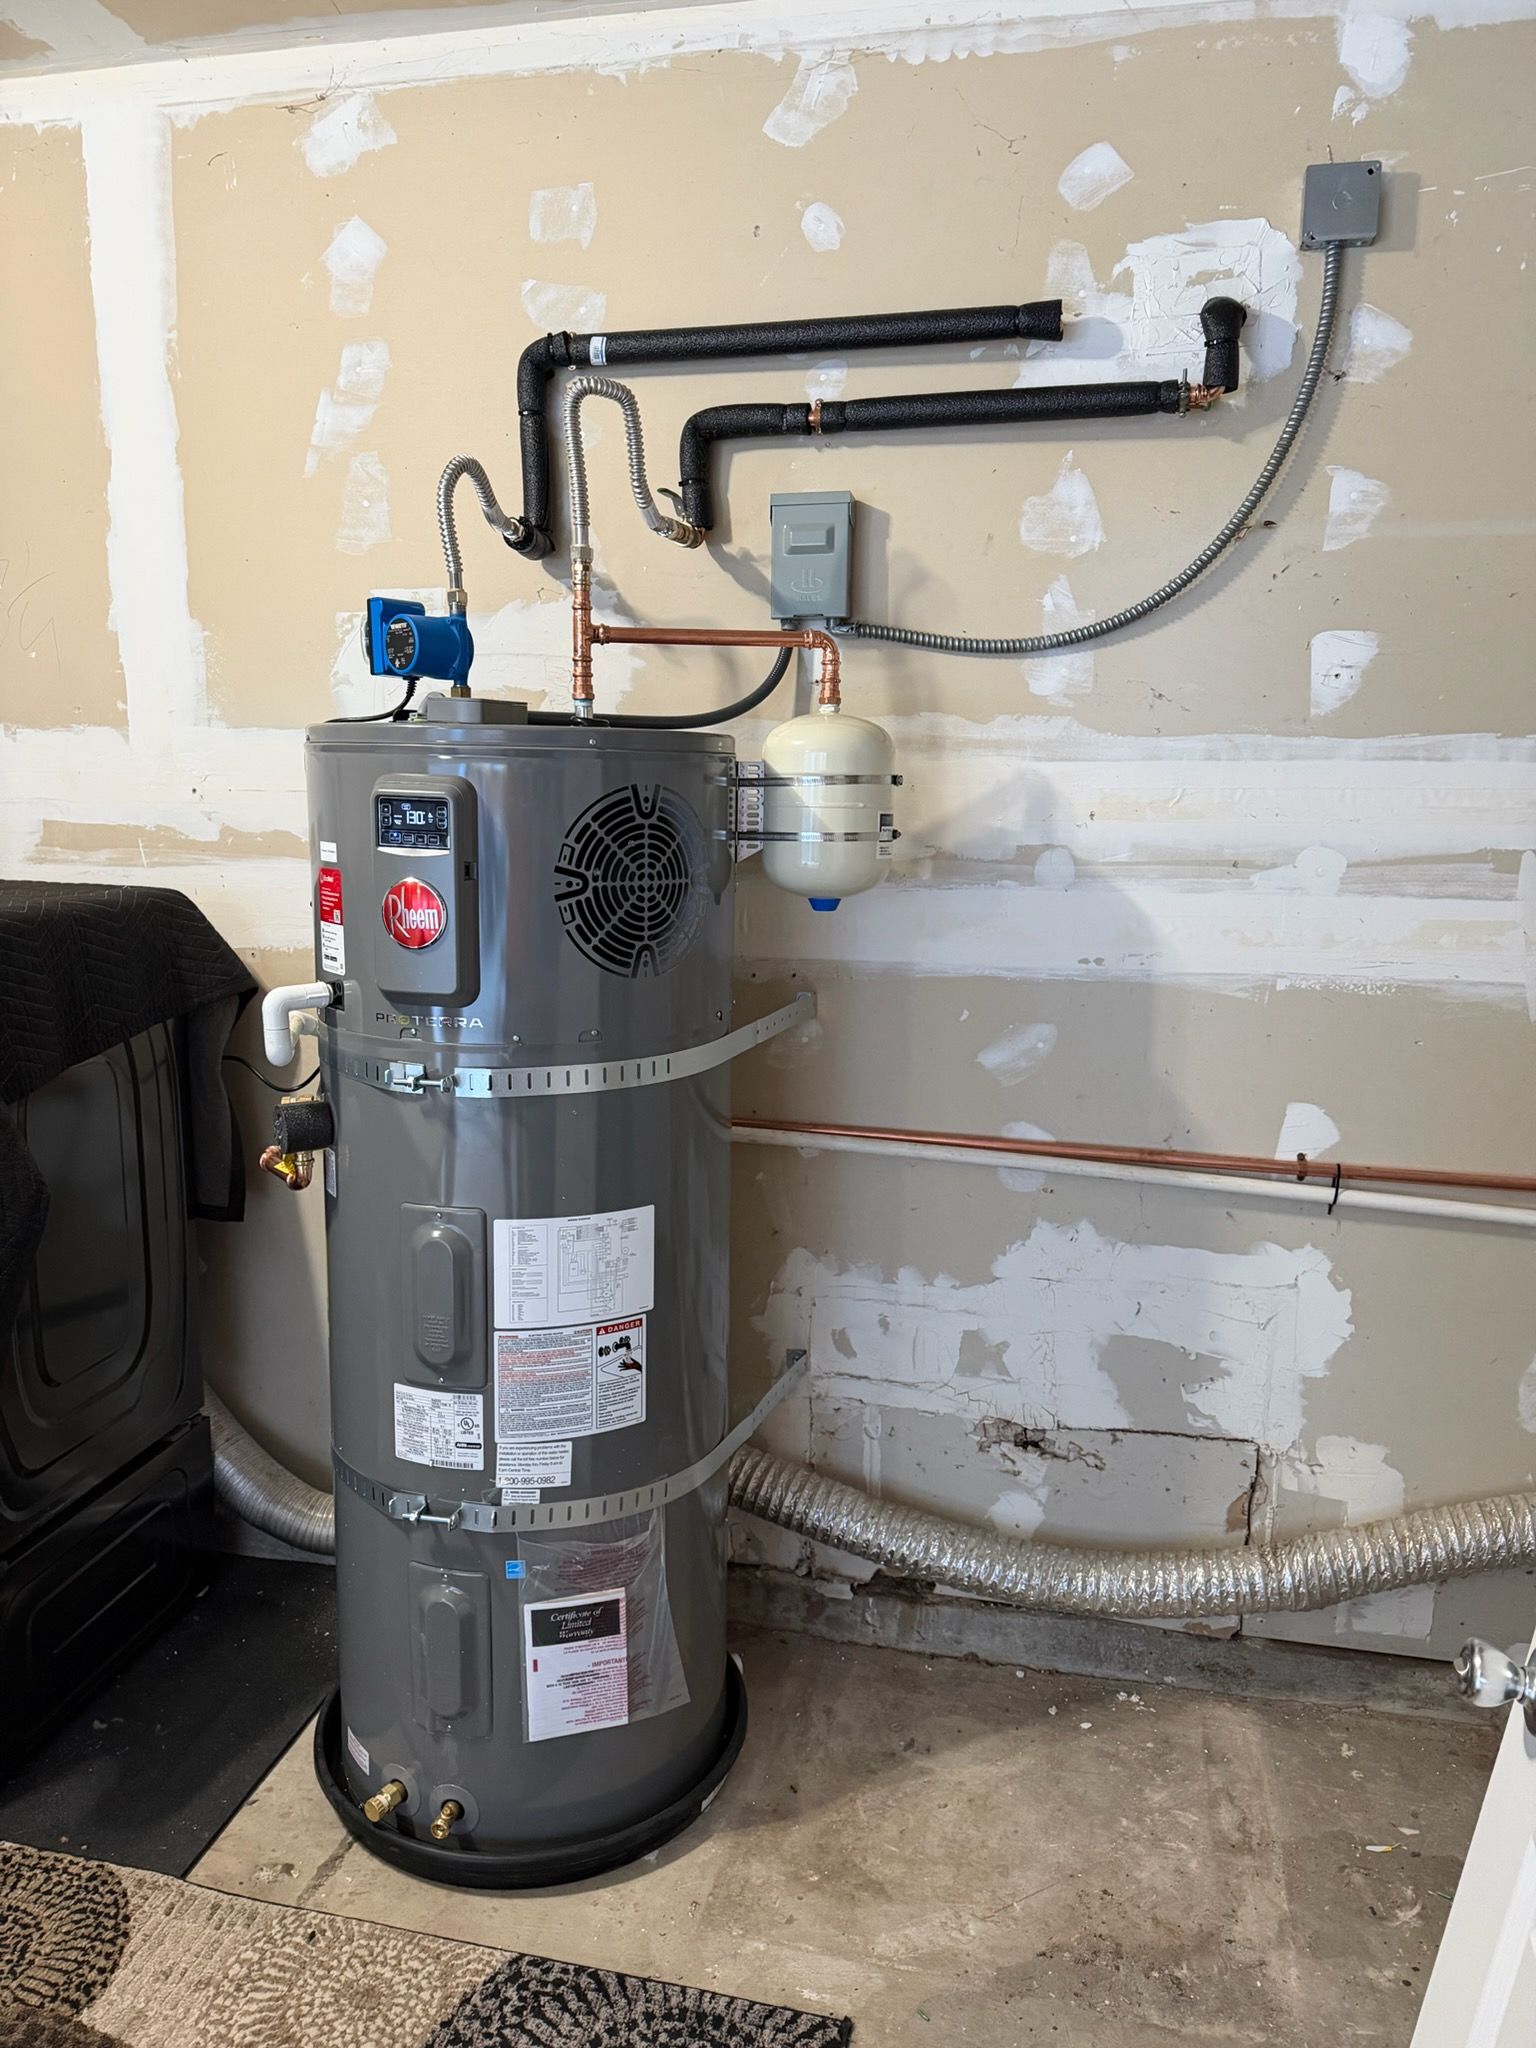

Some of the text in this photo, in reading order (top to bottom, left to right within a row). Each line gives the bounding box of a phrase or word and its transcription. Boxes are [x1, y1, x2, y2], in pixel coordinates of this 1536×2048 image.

[388, 886, 439, 938] Rheem
[375, 1012, 484, 1029] PROTERRA
[607, 1320, 641, 1333] DANGER
[498, 1475, 556, 1486] 100-995-0982
[551, 1606, 604, 1622] Certificate of
[561, 1617, 593, 1630] Limited
[559, 1629, 594, 1639] Warranty
[591, 1657, 627, 1668] IMPORTANT
